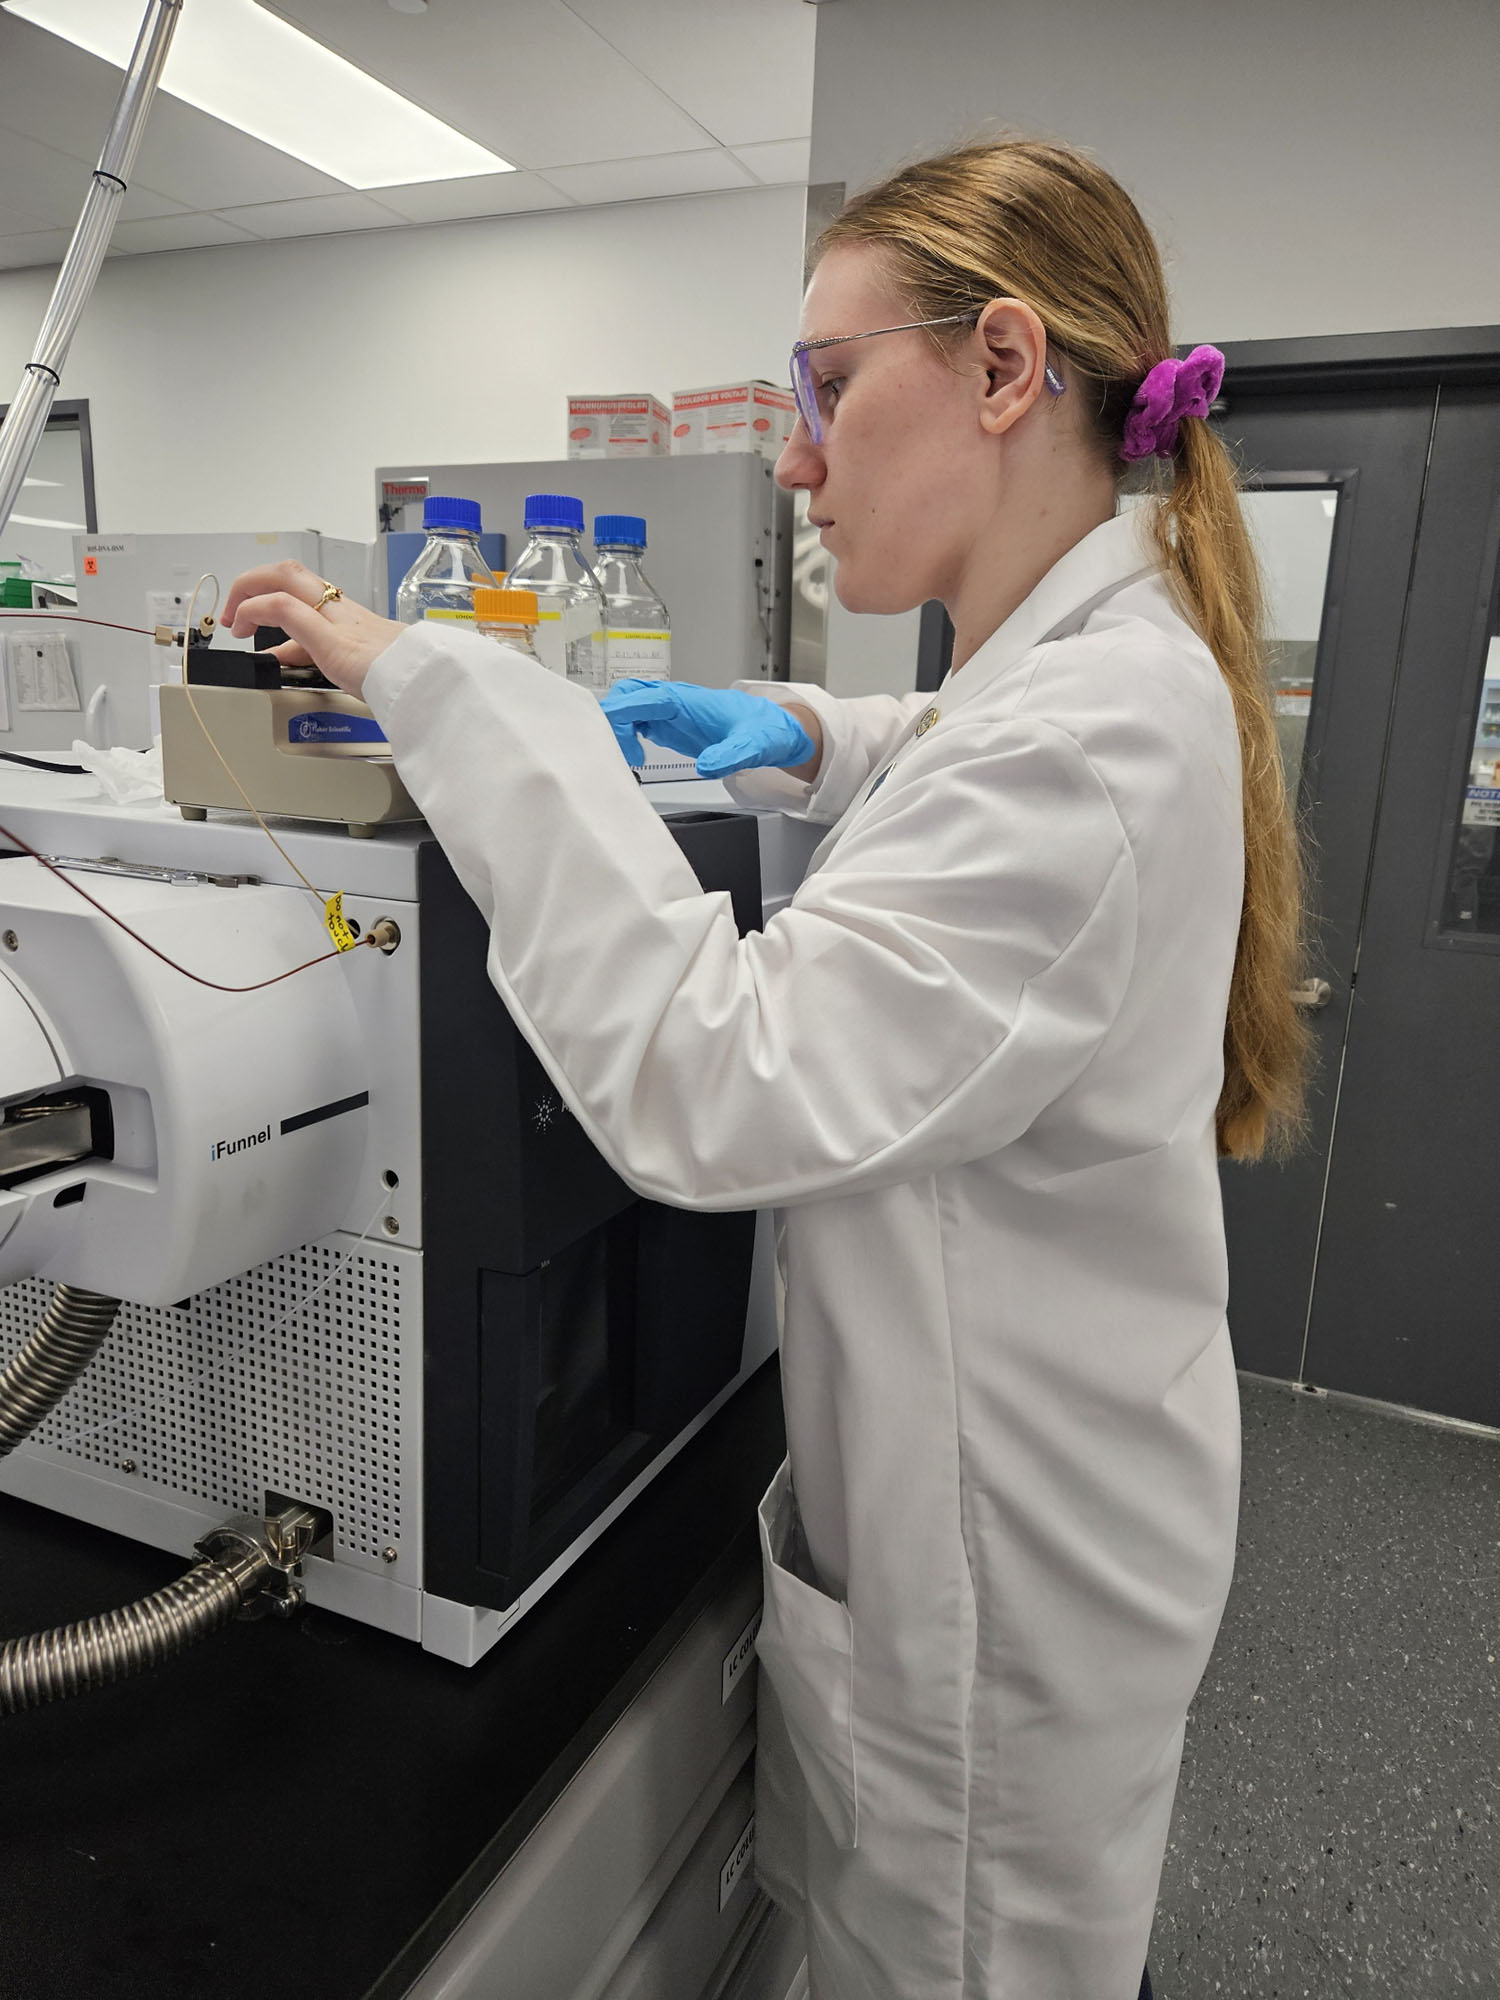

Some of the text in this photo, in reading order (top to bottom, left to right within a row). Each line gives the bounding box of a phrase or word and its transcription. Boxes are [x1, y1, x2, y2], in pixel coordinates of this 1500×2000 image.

[384, 482, 427, 496] Thermo
[336, 915, 350, 939] not
[211, 1124, 271, 1161] iFunnel
[729, 1654, 738, 1678] LC
[726, 1861, 735, 1885] LC
